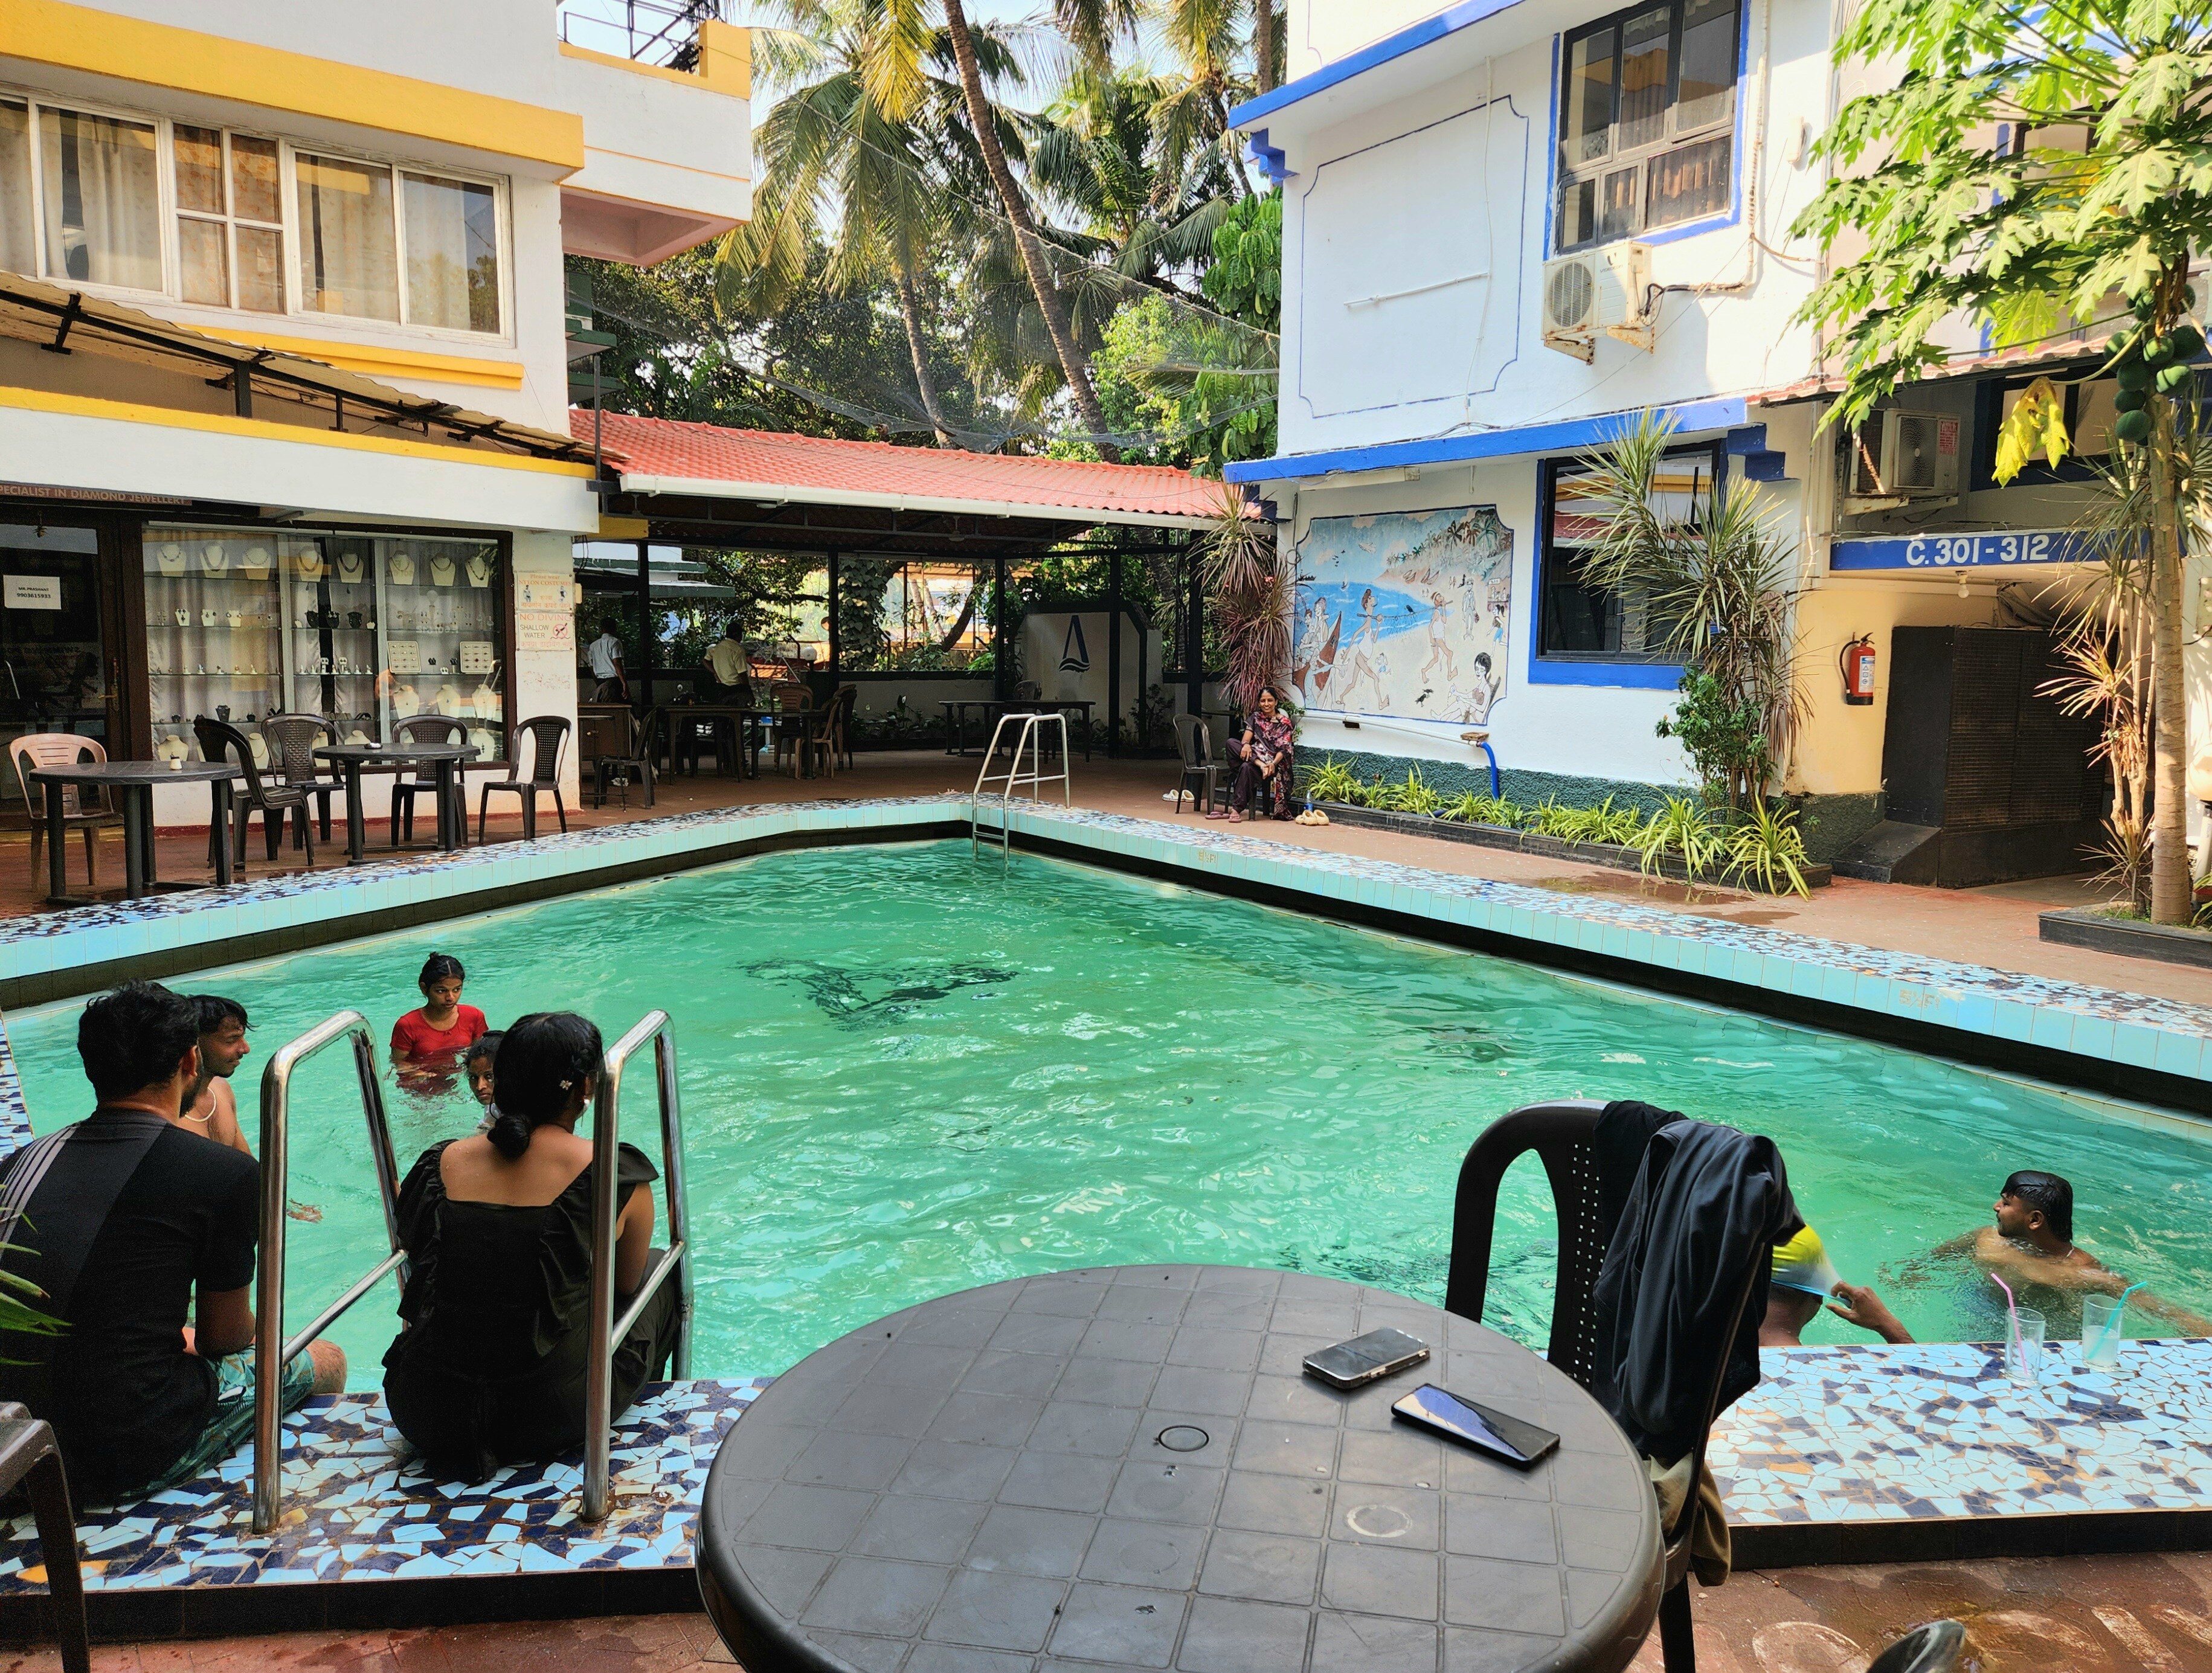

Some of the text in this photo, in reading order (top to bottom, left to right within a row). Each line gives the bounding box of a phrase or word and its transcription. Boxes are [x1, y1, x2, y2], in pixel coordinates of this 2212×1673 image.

[54, 489, 67, 497] IN
[71, 490, 126, 501] DIAMOND
[538, 613, 572, 621] DIVING
